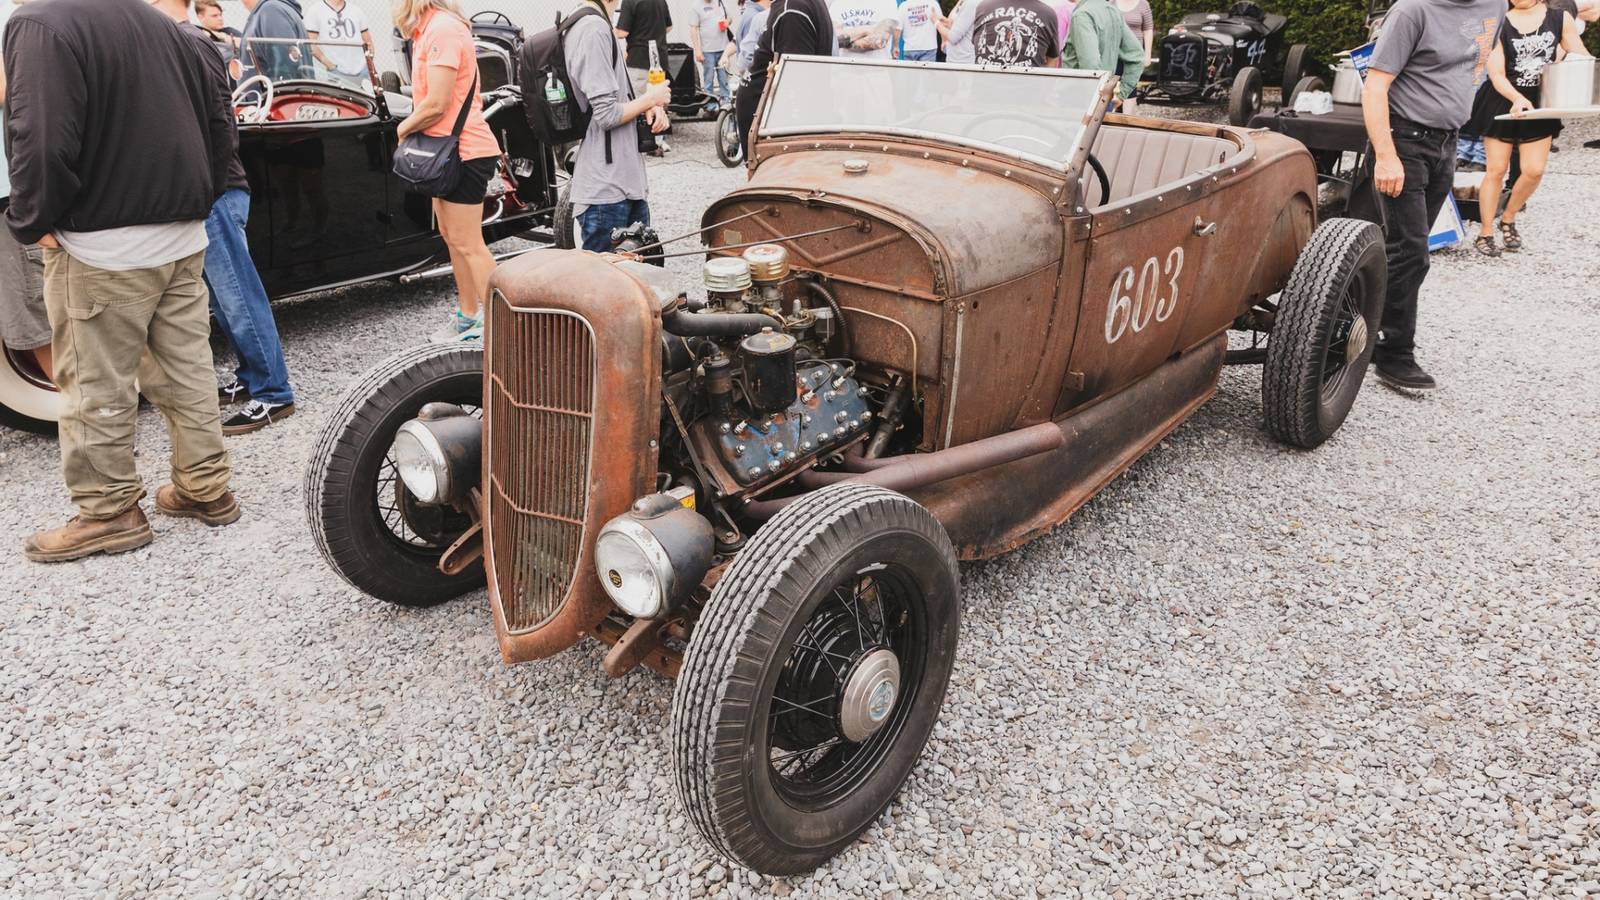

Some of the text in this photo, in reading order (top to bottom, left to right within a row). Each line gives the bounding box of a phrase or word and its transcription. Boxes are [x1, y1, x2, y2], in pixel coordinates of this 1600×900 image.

[995, 6, 1037, 23] RACE
[327, 17, 356, 39] 30
[1104, 246, 1185, 345] 603
